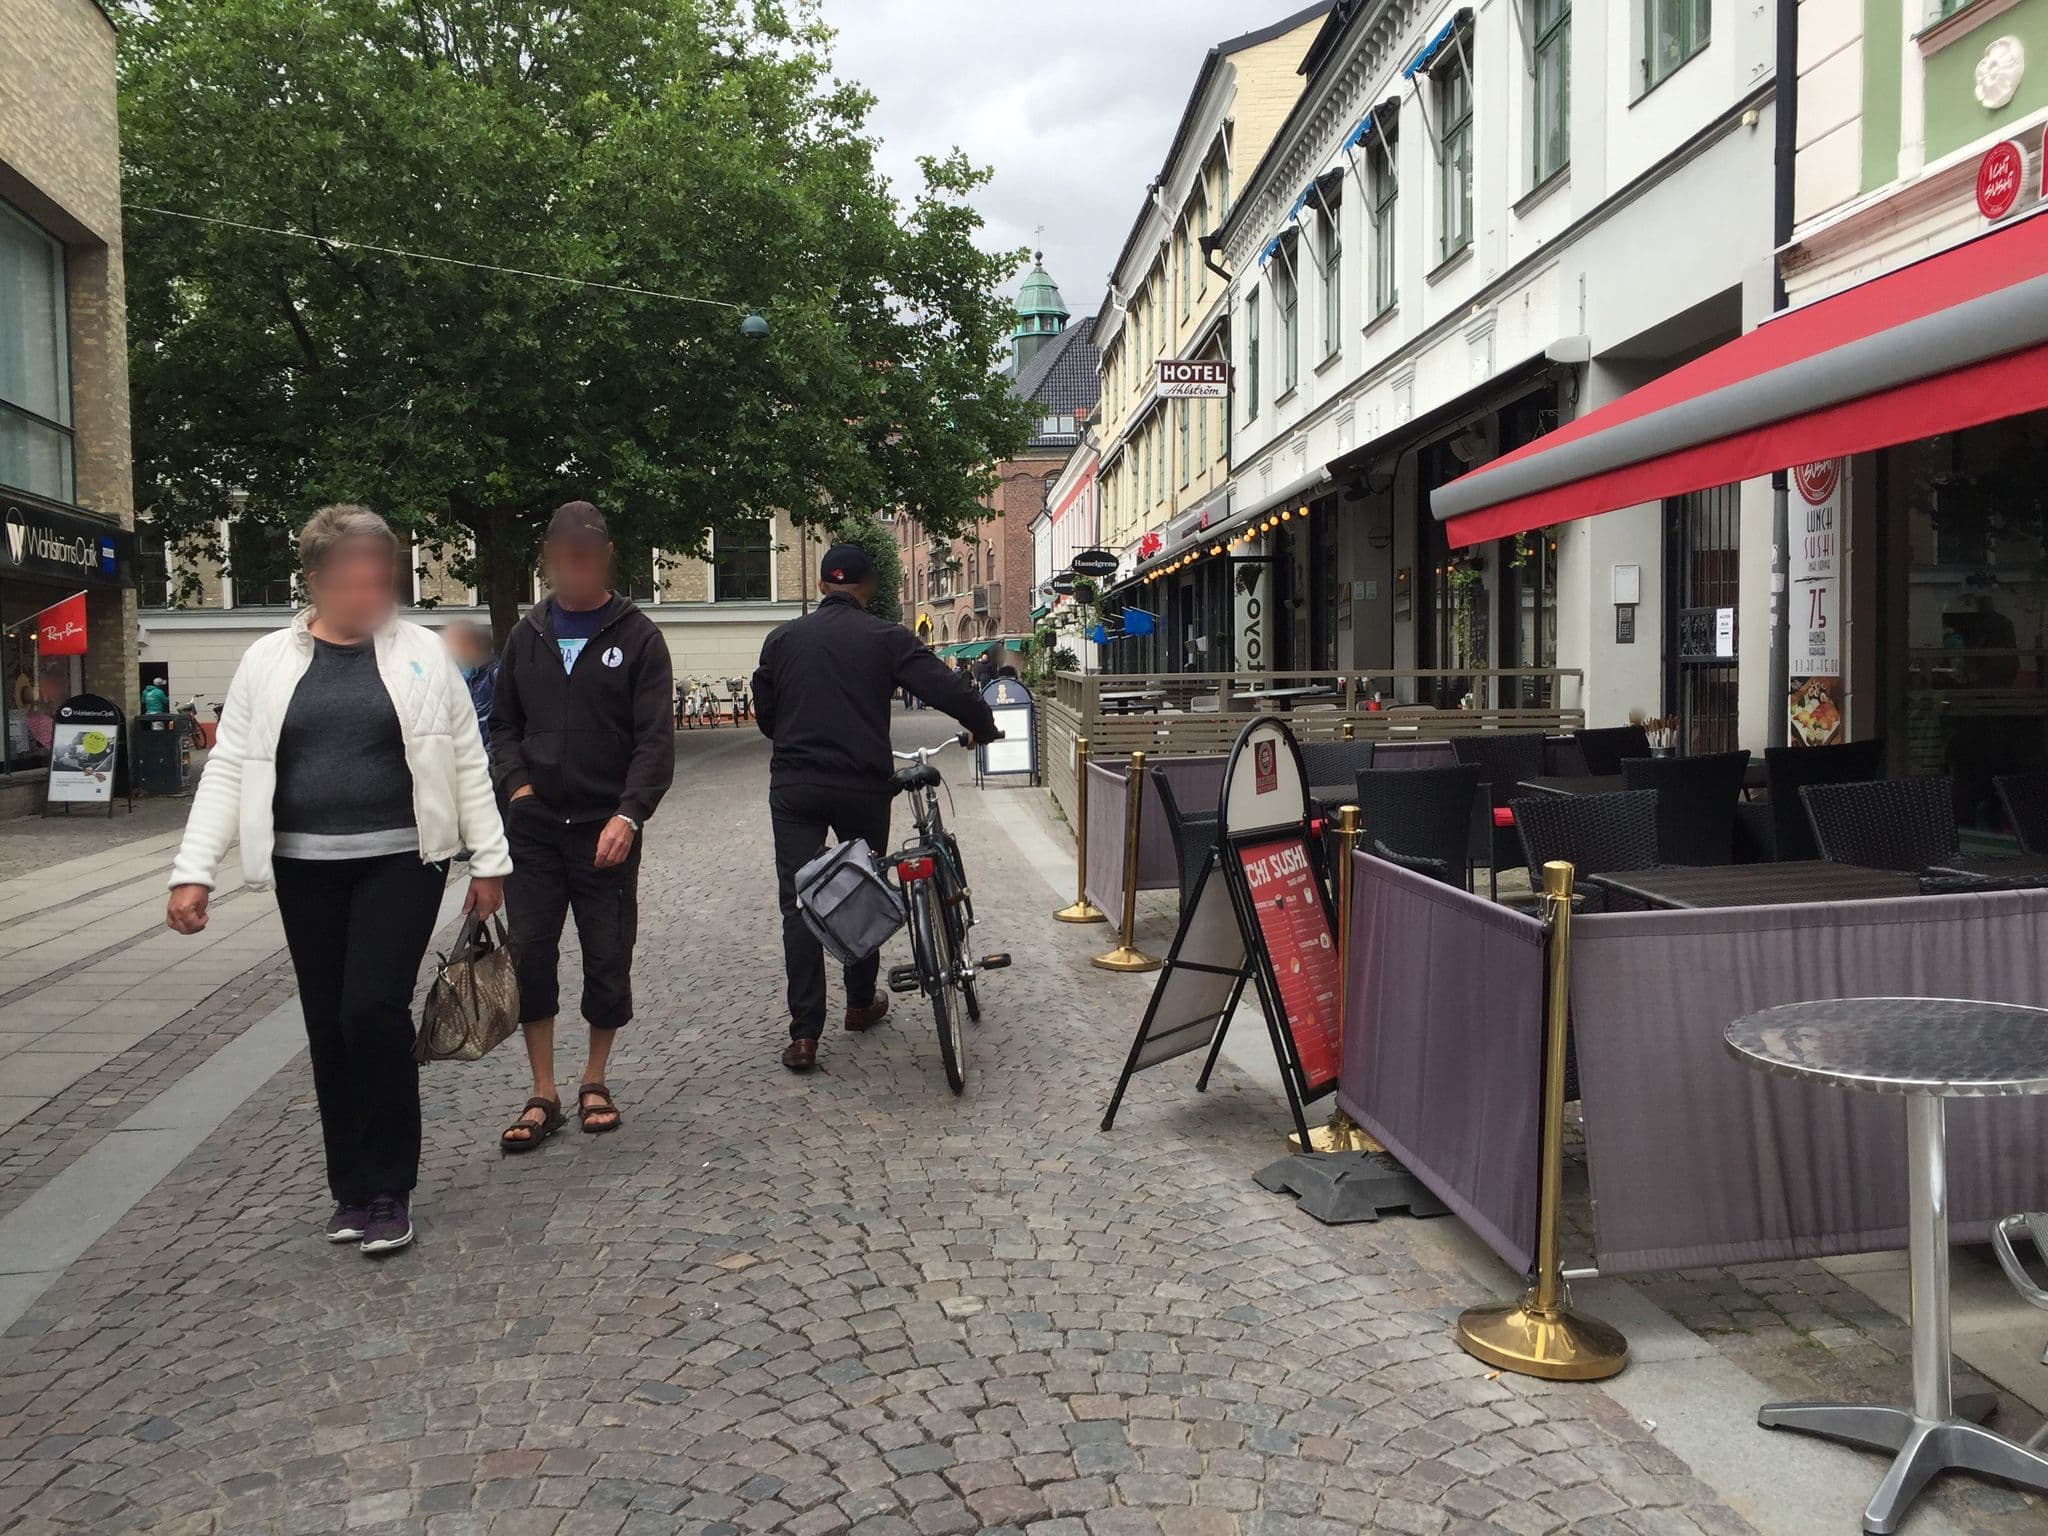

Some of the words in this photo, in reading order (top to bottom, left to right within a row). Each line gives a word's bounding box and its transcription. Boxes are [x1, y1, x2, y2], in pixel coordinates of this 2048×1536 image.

[1163, 365, 1225, 381] HOTEL
[1166, 383, 1219, 396] Ahlström
[1807, 507, 1833, 533] LUNCH
[1804, 533, 1834, 560] SUSHI
[1074, 559, 1117, 569] Hasselgrens
[1809, 588, 1827, 629] 75
[41, 621, 84, 641] Ray-Ban
[1245, 858, 1272, 890] CHI
[1269, 844, 1308, 879] SUSHI
